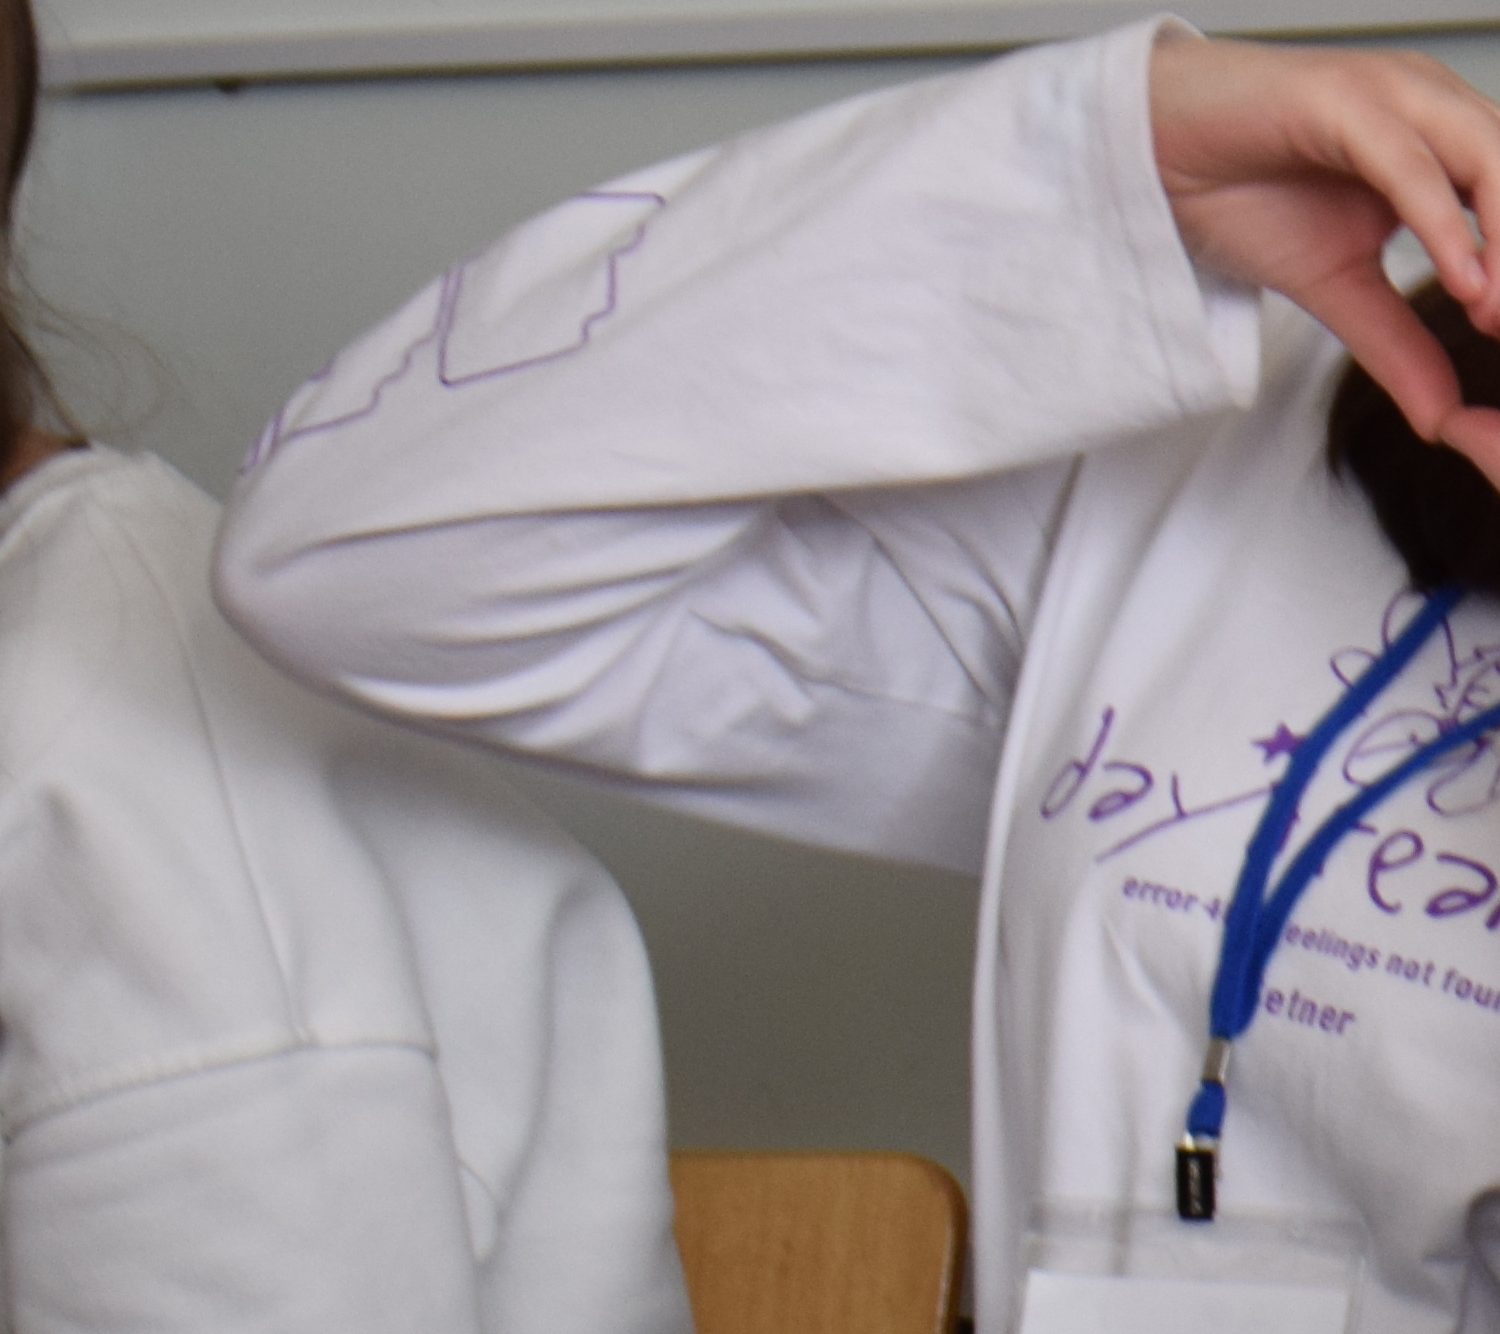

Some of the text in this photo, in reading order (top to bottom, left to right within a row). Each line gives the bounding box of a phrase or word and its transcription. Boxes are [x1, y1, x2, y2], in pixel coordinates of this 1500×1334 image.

[1123, 875, 1199, 913] error
[1284, 923, 1381, 971] eelings
[1386, 953, 1435, 987] not
